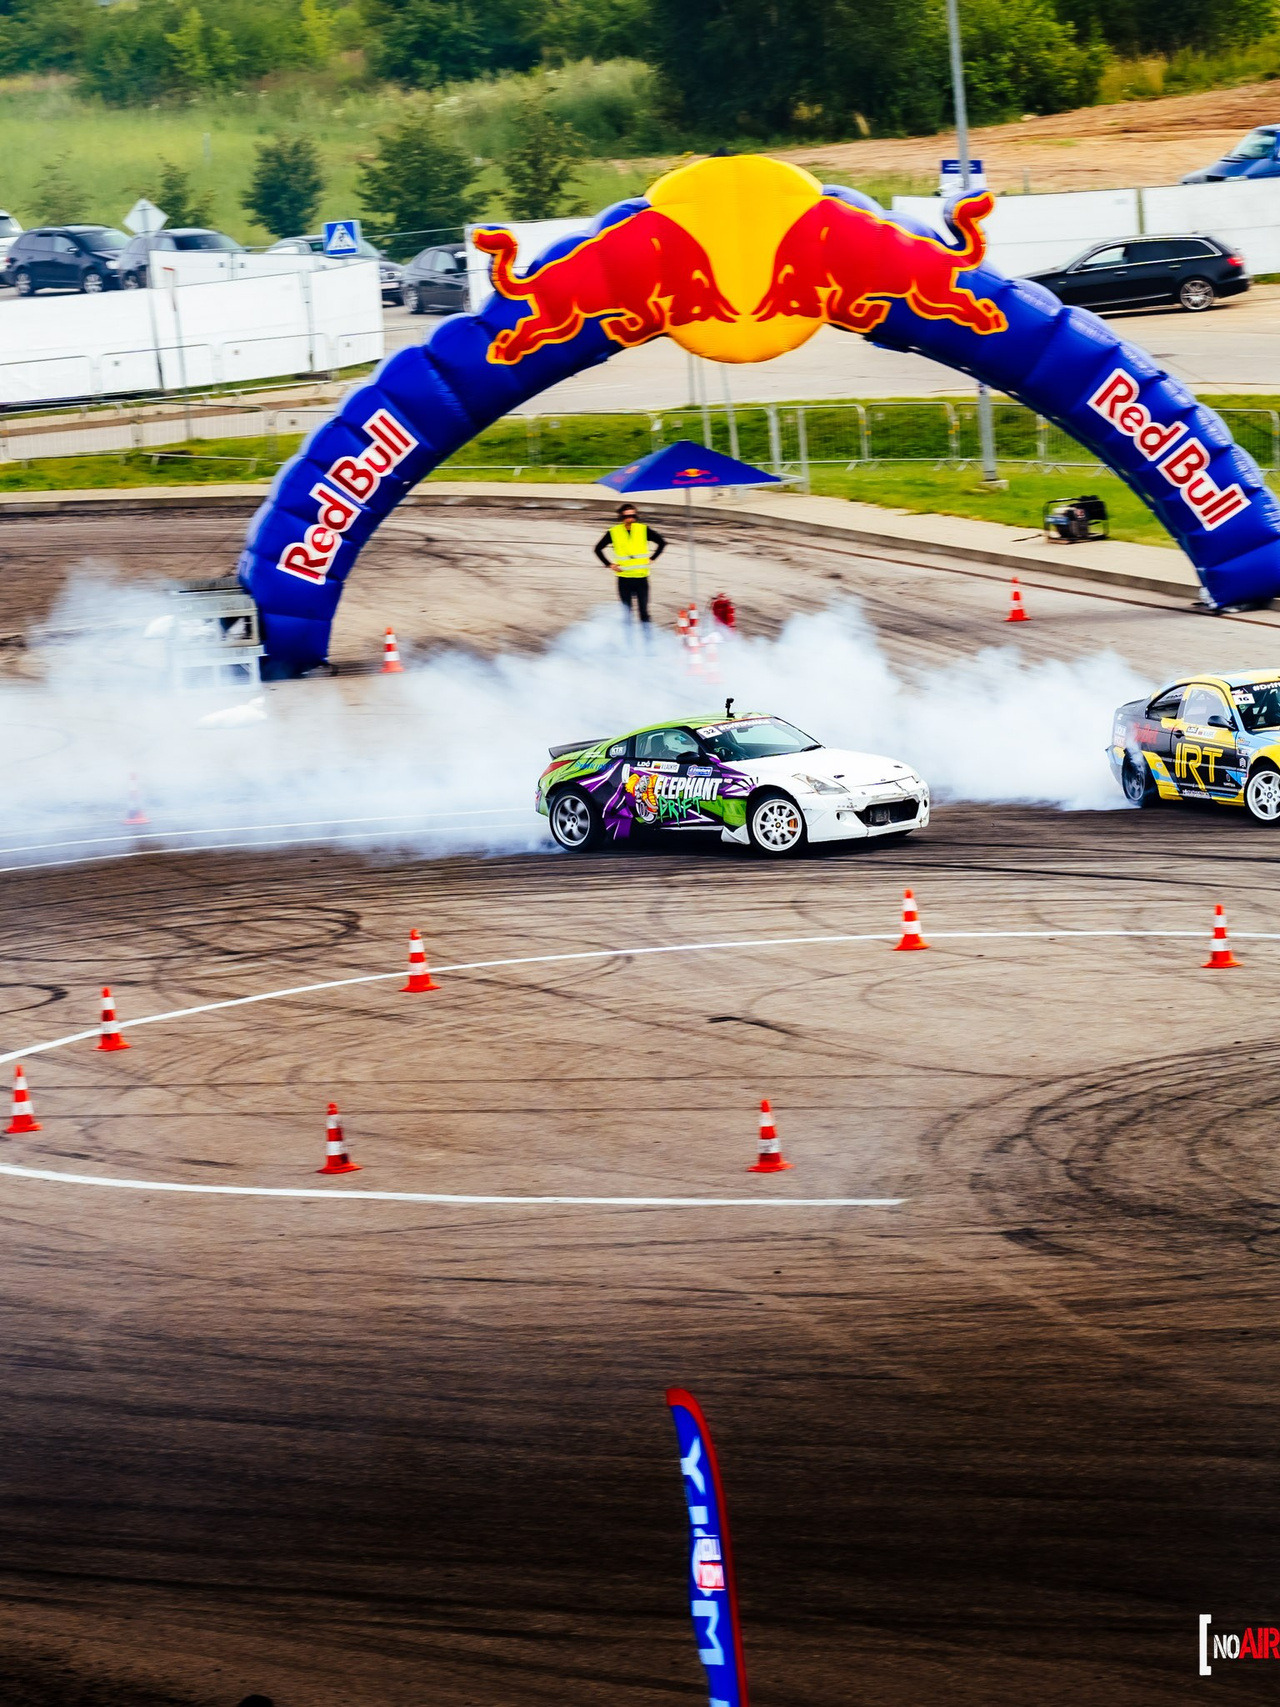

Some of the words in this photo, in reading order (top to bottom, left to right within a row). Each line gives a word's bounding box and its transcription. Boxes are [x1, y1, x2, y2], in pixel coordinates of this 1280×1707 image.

[1088, 370, 1187, 460] Red
[1158, 439, 1250, 530] Bull
[278, 484, 360, 583] Red
[325, 410, 417, 502] Bull
[655, 776, 722, 801] ELEPHANT
[1175, 742, 1223, 792] IRT
[658, 796, 702, 825] DRIFT
